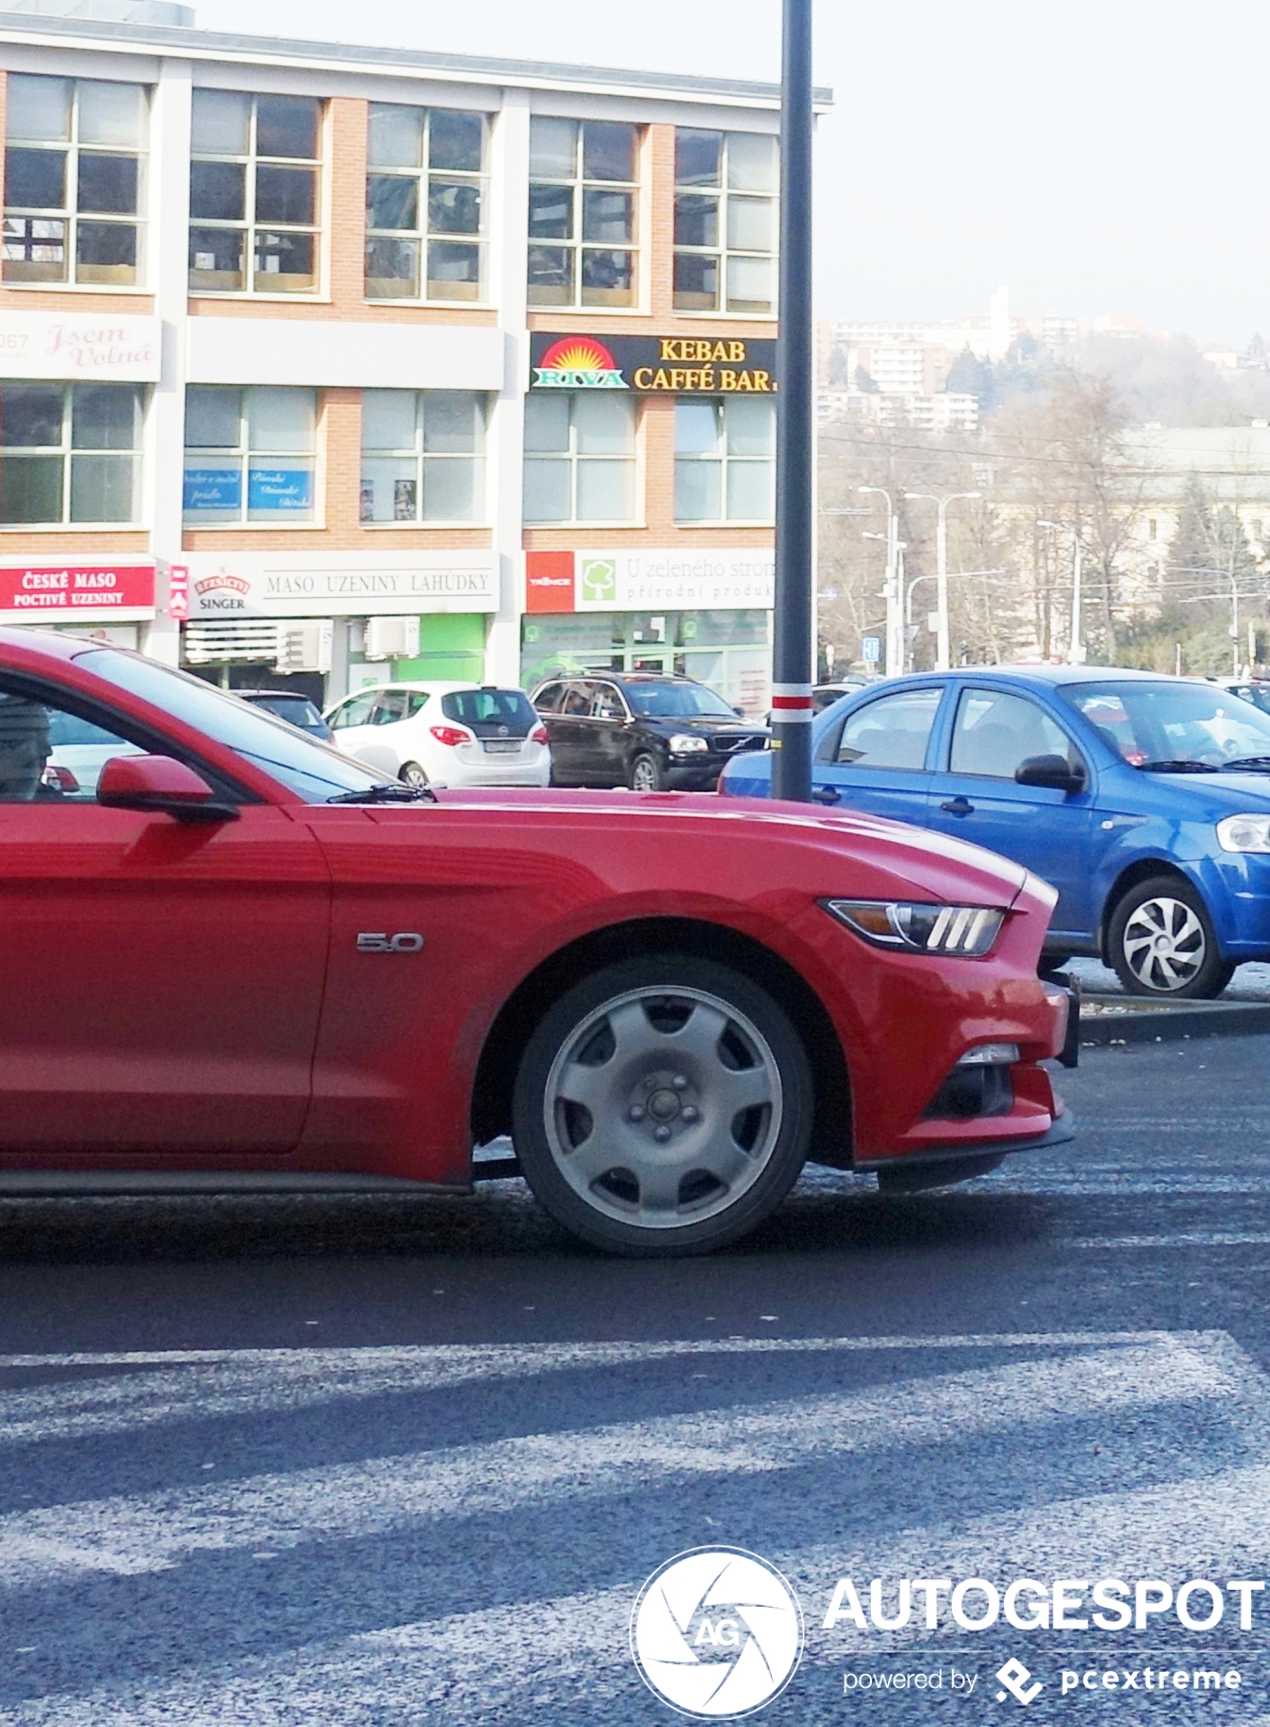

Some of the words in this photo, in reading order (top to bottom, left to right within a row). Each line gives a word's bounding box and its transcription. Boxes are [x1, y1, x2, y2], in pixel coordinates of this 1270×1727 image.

[660, 339, 746, 363] KEBAB
[540, 370, 622, 386] RIVA
[634, 364, 715, 391] CAFFÉ
[719, 369, 771, 392] BAR
[626, 558, 640, 578] U
[646, 558, 726, 578] zeleného
[21, 571, 69, 589] ČESKÉ
[74, 572, 117, 589] MASO
[266, 576, 316, 593] MASO
[326, 574, 400, 593] UZENINY
[411, 569, 489, 592] LAHŮDKY
[13, 592, 67, 607] POCTIVÉ
[71, 592, 125, 605] UZENINY
[627, 584, 704, 602] přírodní
[713, 583, 774, 601] produk
[199, 598, 245, 610] SINGER
[356, 932, 425, 953] 5.0
